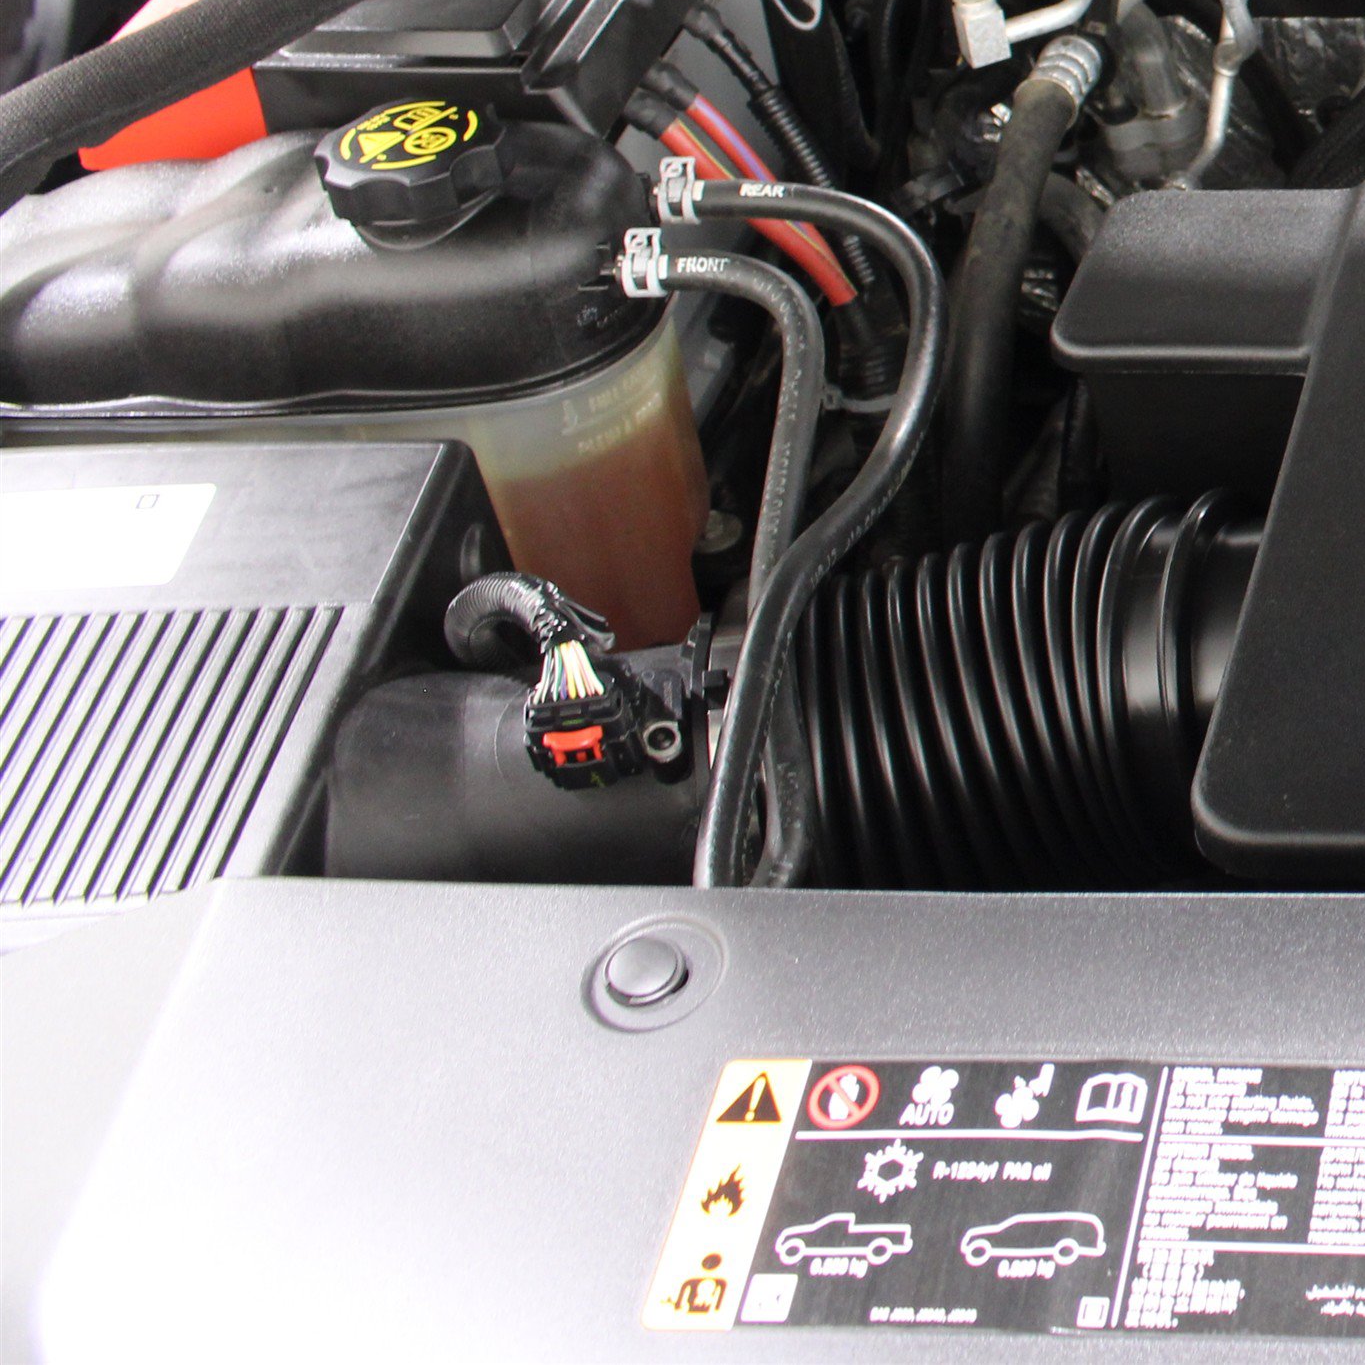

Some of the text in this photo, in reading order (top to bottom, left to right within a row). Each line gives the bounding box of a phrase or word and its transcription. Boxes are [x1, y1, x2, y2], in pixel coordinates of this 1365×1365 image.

[739, 183, 785, 197] REAR
[676, 256, 730, 273] FRONT
[900, 1103, 955, 1126] AUTO
